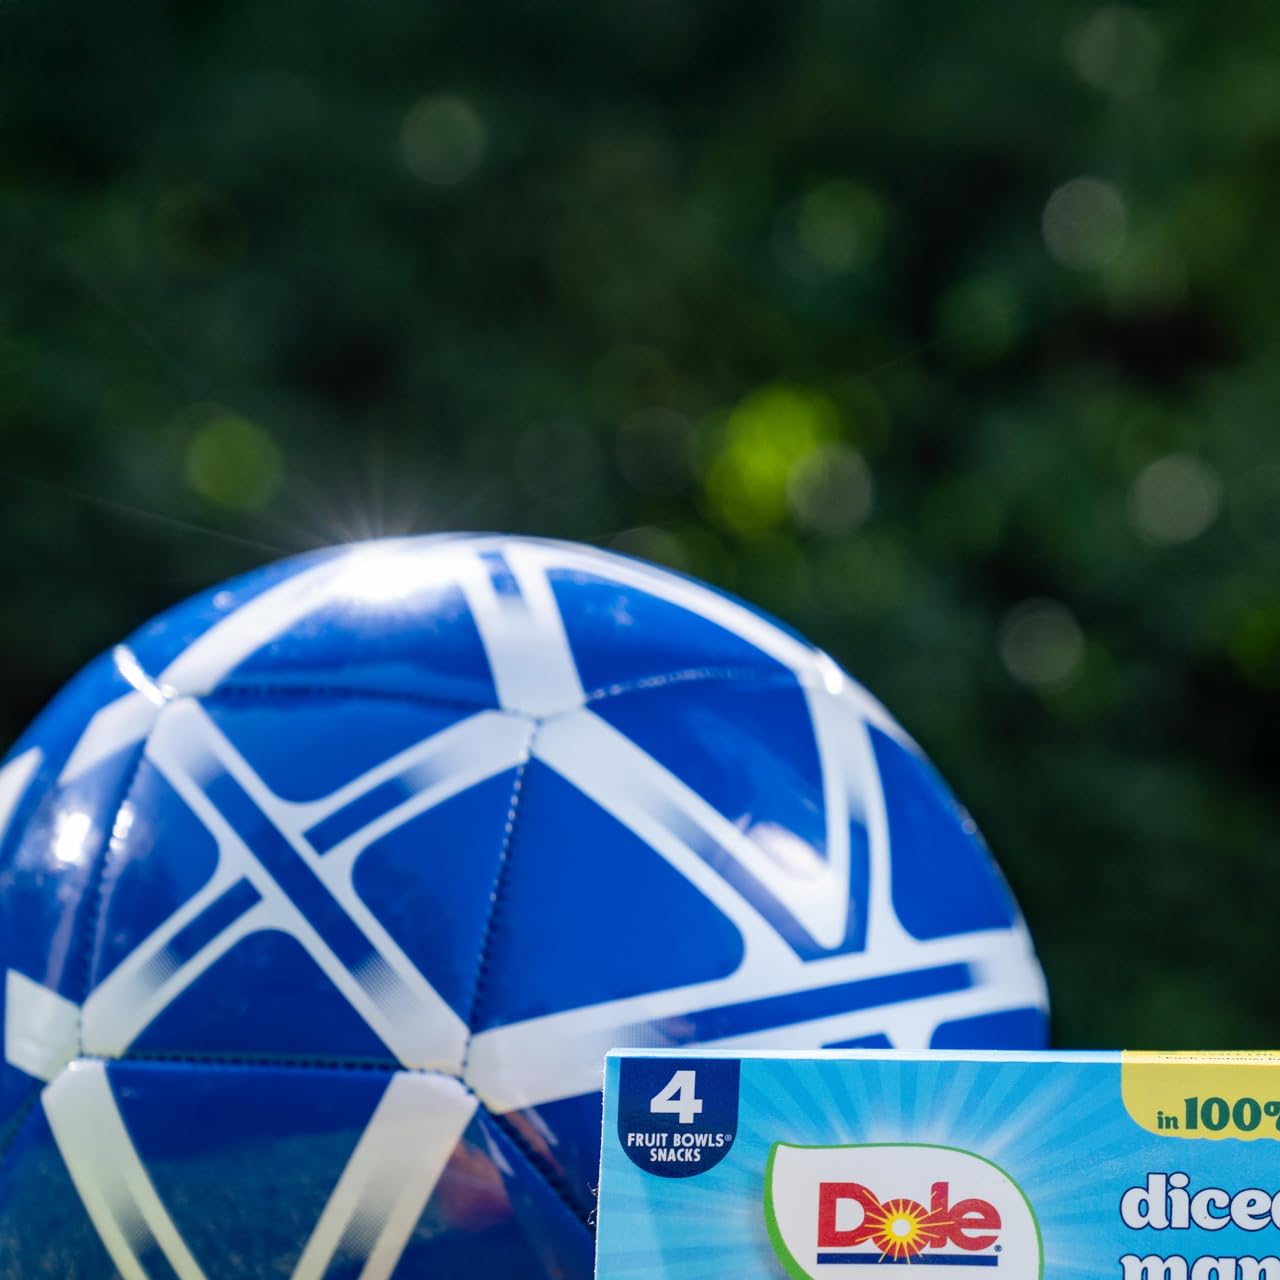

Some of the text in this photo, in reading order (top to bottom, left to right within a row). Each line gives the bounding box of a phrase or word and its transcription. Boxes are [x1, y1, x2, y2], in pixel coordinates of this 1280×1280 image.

[650, 1070, 703, 1124] 4
[1157, 1111, 1179, 1130] in
[627, 1133, 668, 1147] FRUIT
[650, 1148, 701, 1162] SNACKS
